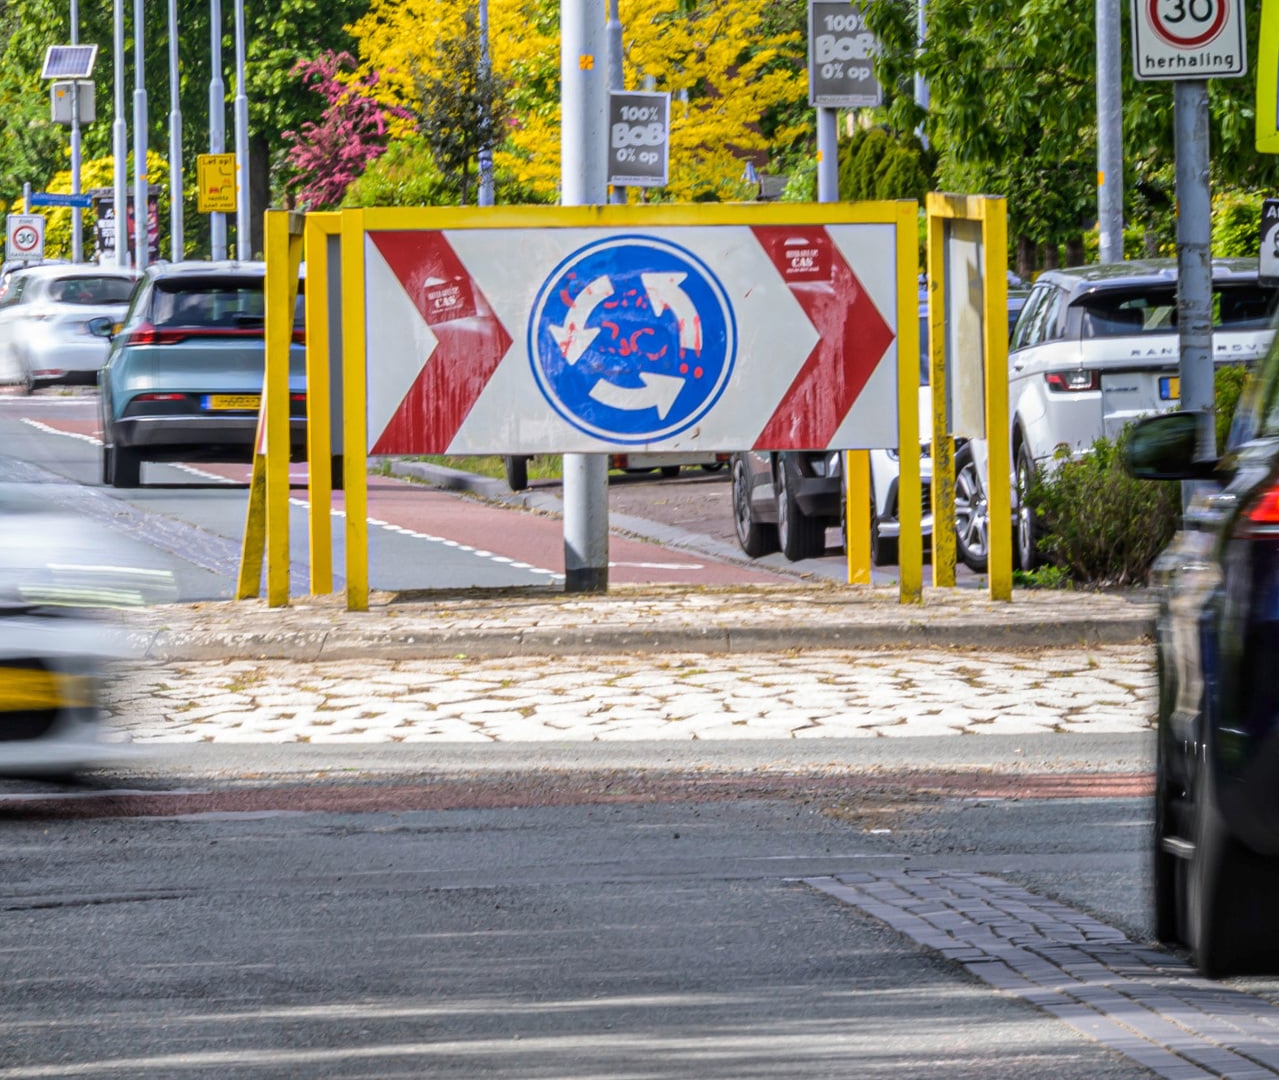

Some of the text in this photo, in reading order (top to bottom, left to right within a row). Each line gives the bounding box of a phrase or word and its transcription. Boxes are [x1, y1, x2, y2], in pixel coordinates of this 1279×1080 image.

[1145, 53, 1234, 69] herhaling
[821, 63, 870, 82] 0% op
[620, 106, 658, 121] 100%
[612, 122, 665, 148] BOB
[616, 148, 659, 165] 0% op
[18, 233, 35, 244] 30
